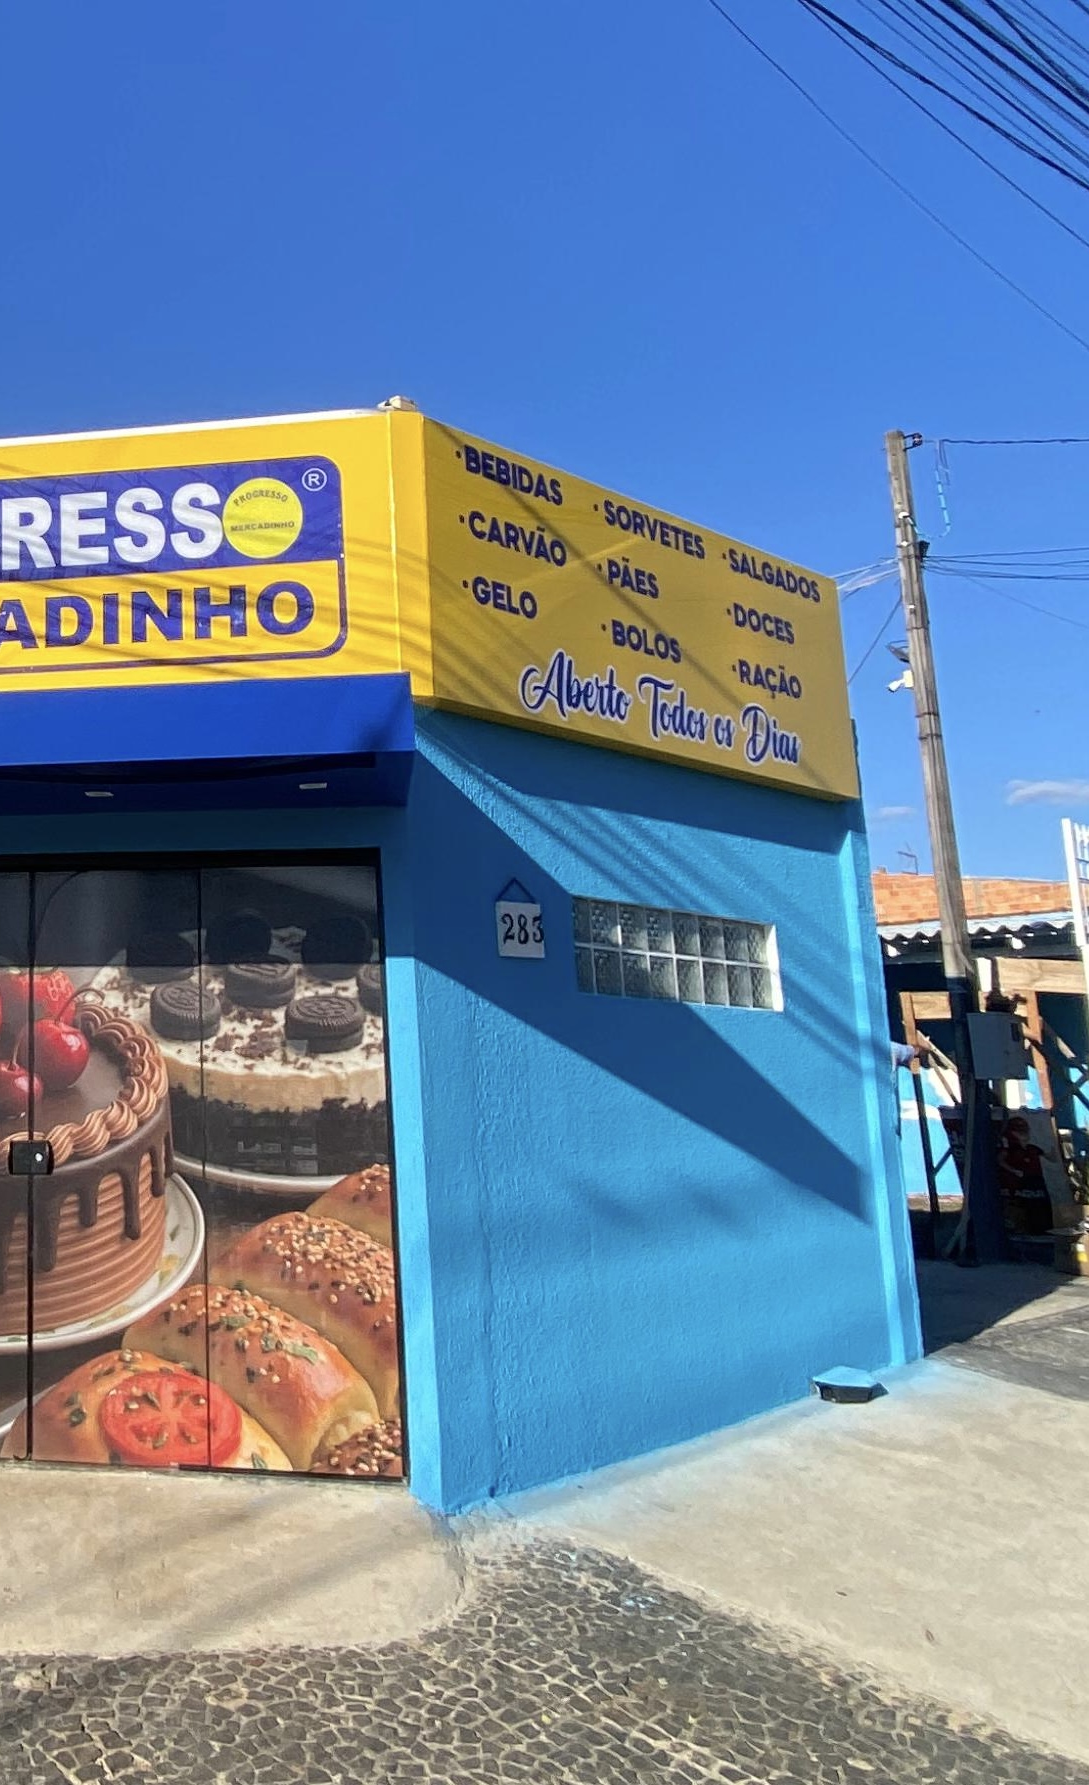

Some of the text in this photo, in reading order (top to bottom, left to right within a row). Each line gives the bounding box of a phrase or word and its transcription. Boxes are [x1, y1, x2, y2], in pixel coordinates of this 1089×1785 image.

[464, 445, 563, 506] BEBIDAS
[233, 489, 289, 507] PROGRESSO
[230, 520, 296, 532] MERCADINHO
[468, 511, 568, 567] CARVÃO
[604, 500, 706, 560] SORVETES
[607, 556, 660, 600] PÃES
[728, 548, 822, 603] SALGADOS
[472, 576, 538, 620] GELO
[611, 619, 682, 664] BOLOS
[733, 602, 795, 645] DOCES
[738, 659, 803, 700] RAÇÃO
[519, 650, 799, 764] Aberto Todos os Dias
[501, 912, 545, 945] 283
